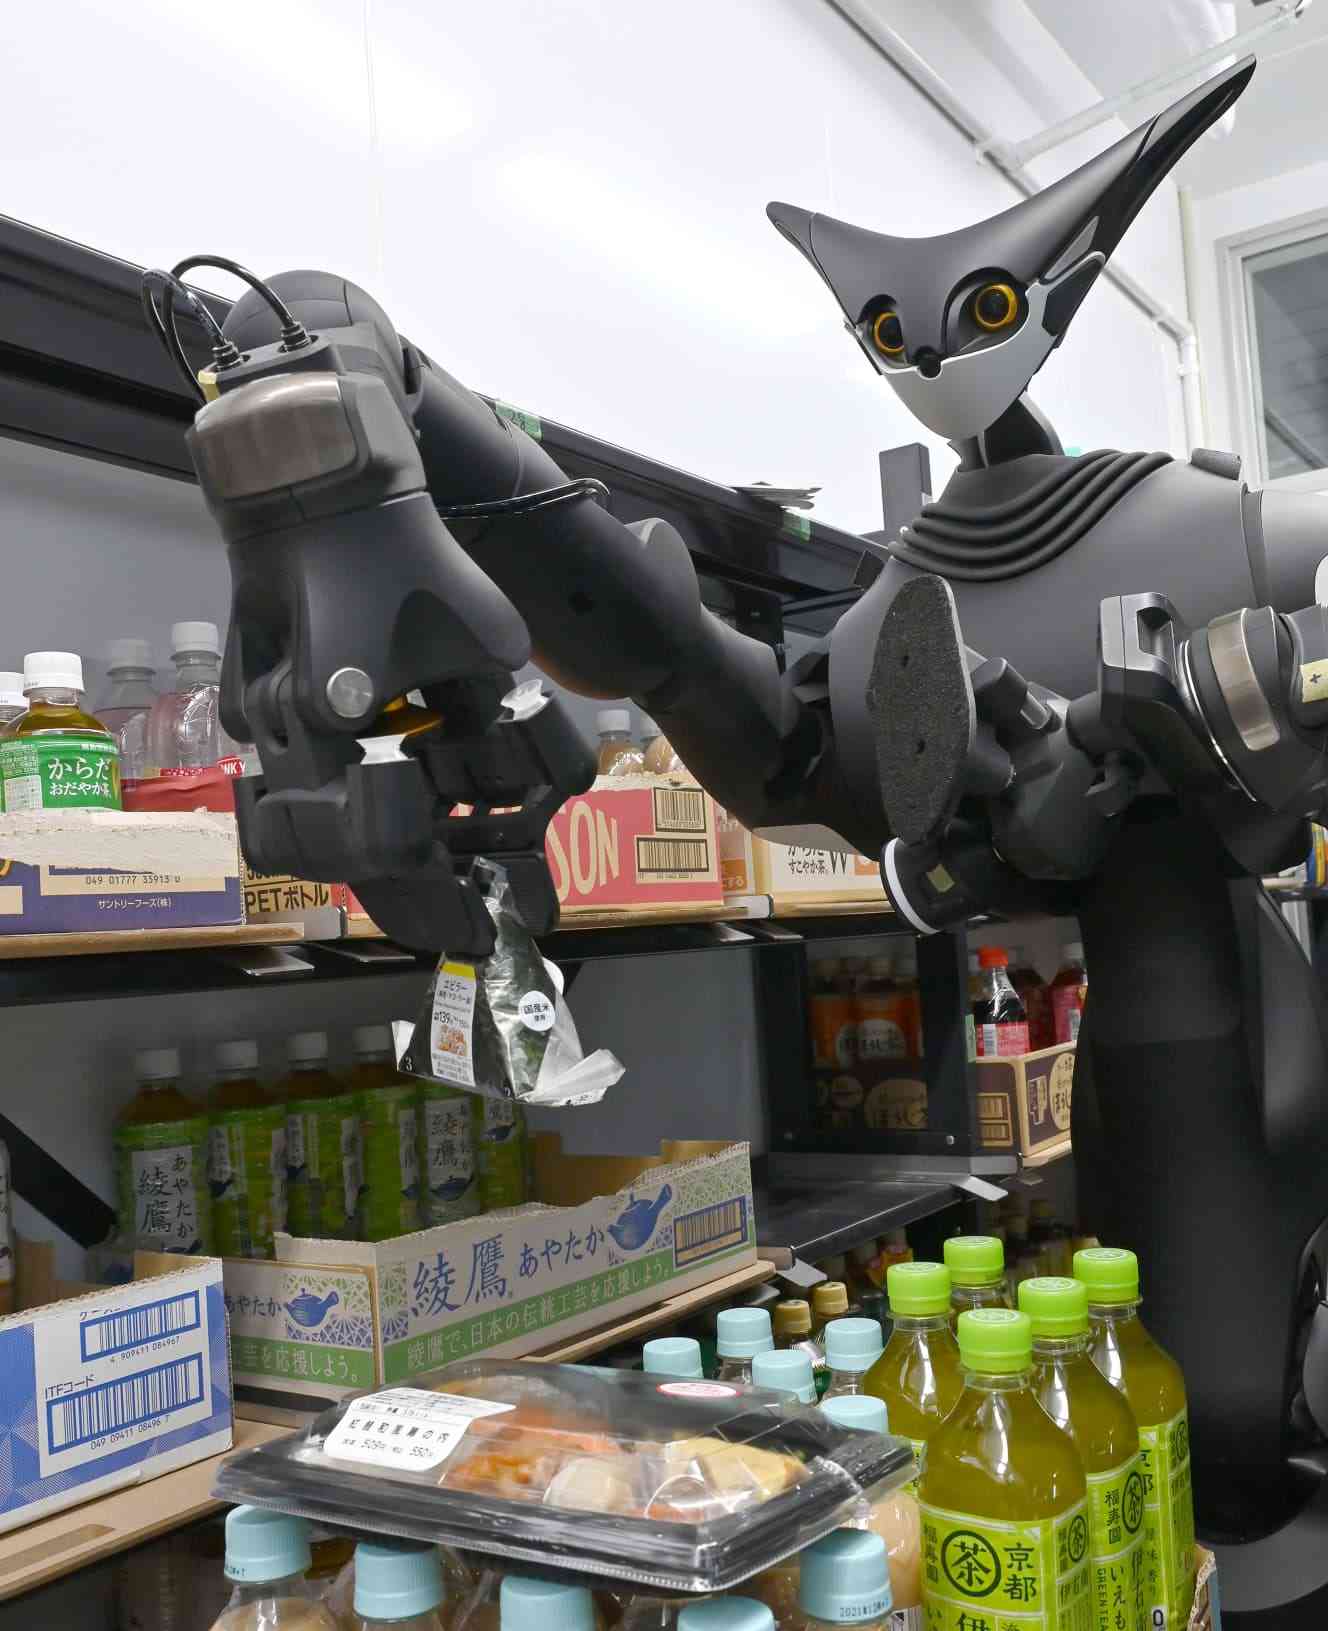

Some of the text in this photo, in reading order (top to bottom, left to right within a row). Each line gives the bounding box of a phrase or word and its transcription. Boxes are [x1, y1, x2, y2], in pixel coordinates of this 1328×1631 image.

[48, 757, 111, 780] からだ
[245, 884, 328, 913] PETボトル
[139, 1166, 173, 1233] 綾鷹
[411, 1226, 605, 1317] 綾鷹 あやたか
[45, 1374, 95, 1399] ITFコード
[952, 1541, 992, 1587] 茶
[1003, 1542, 1037, 1602] 京都
